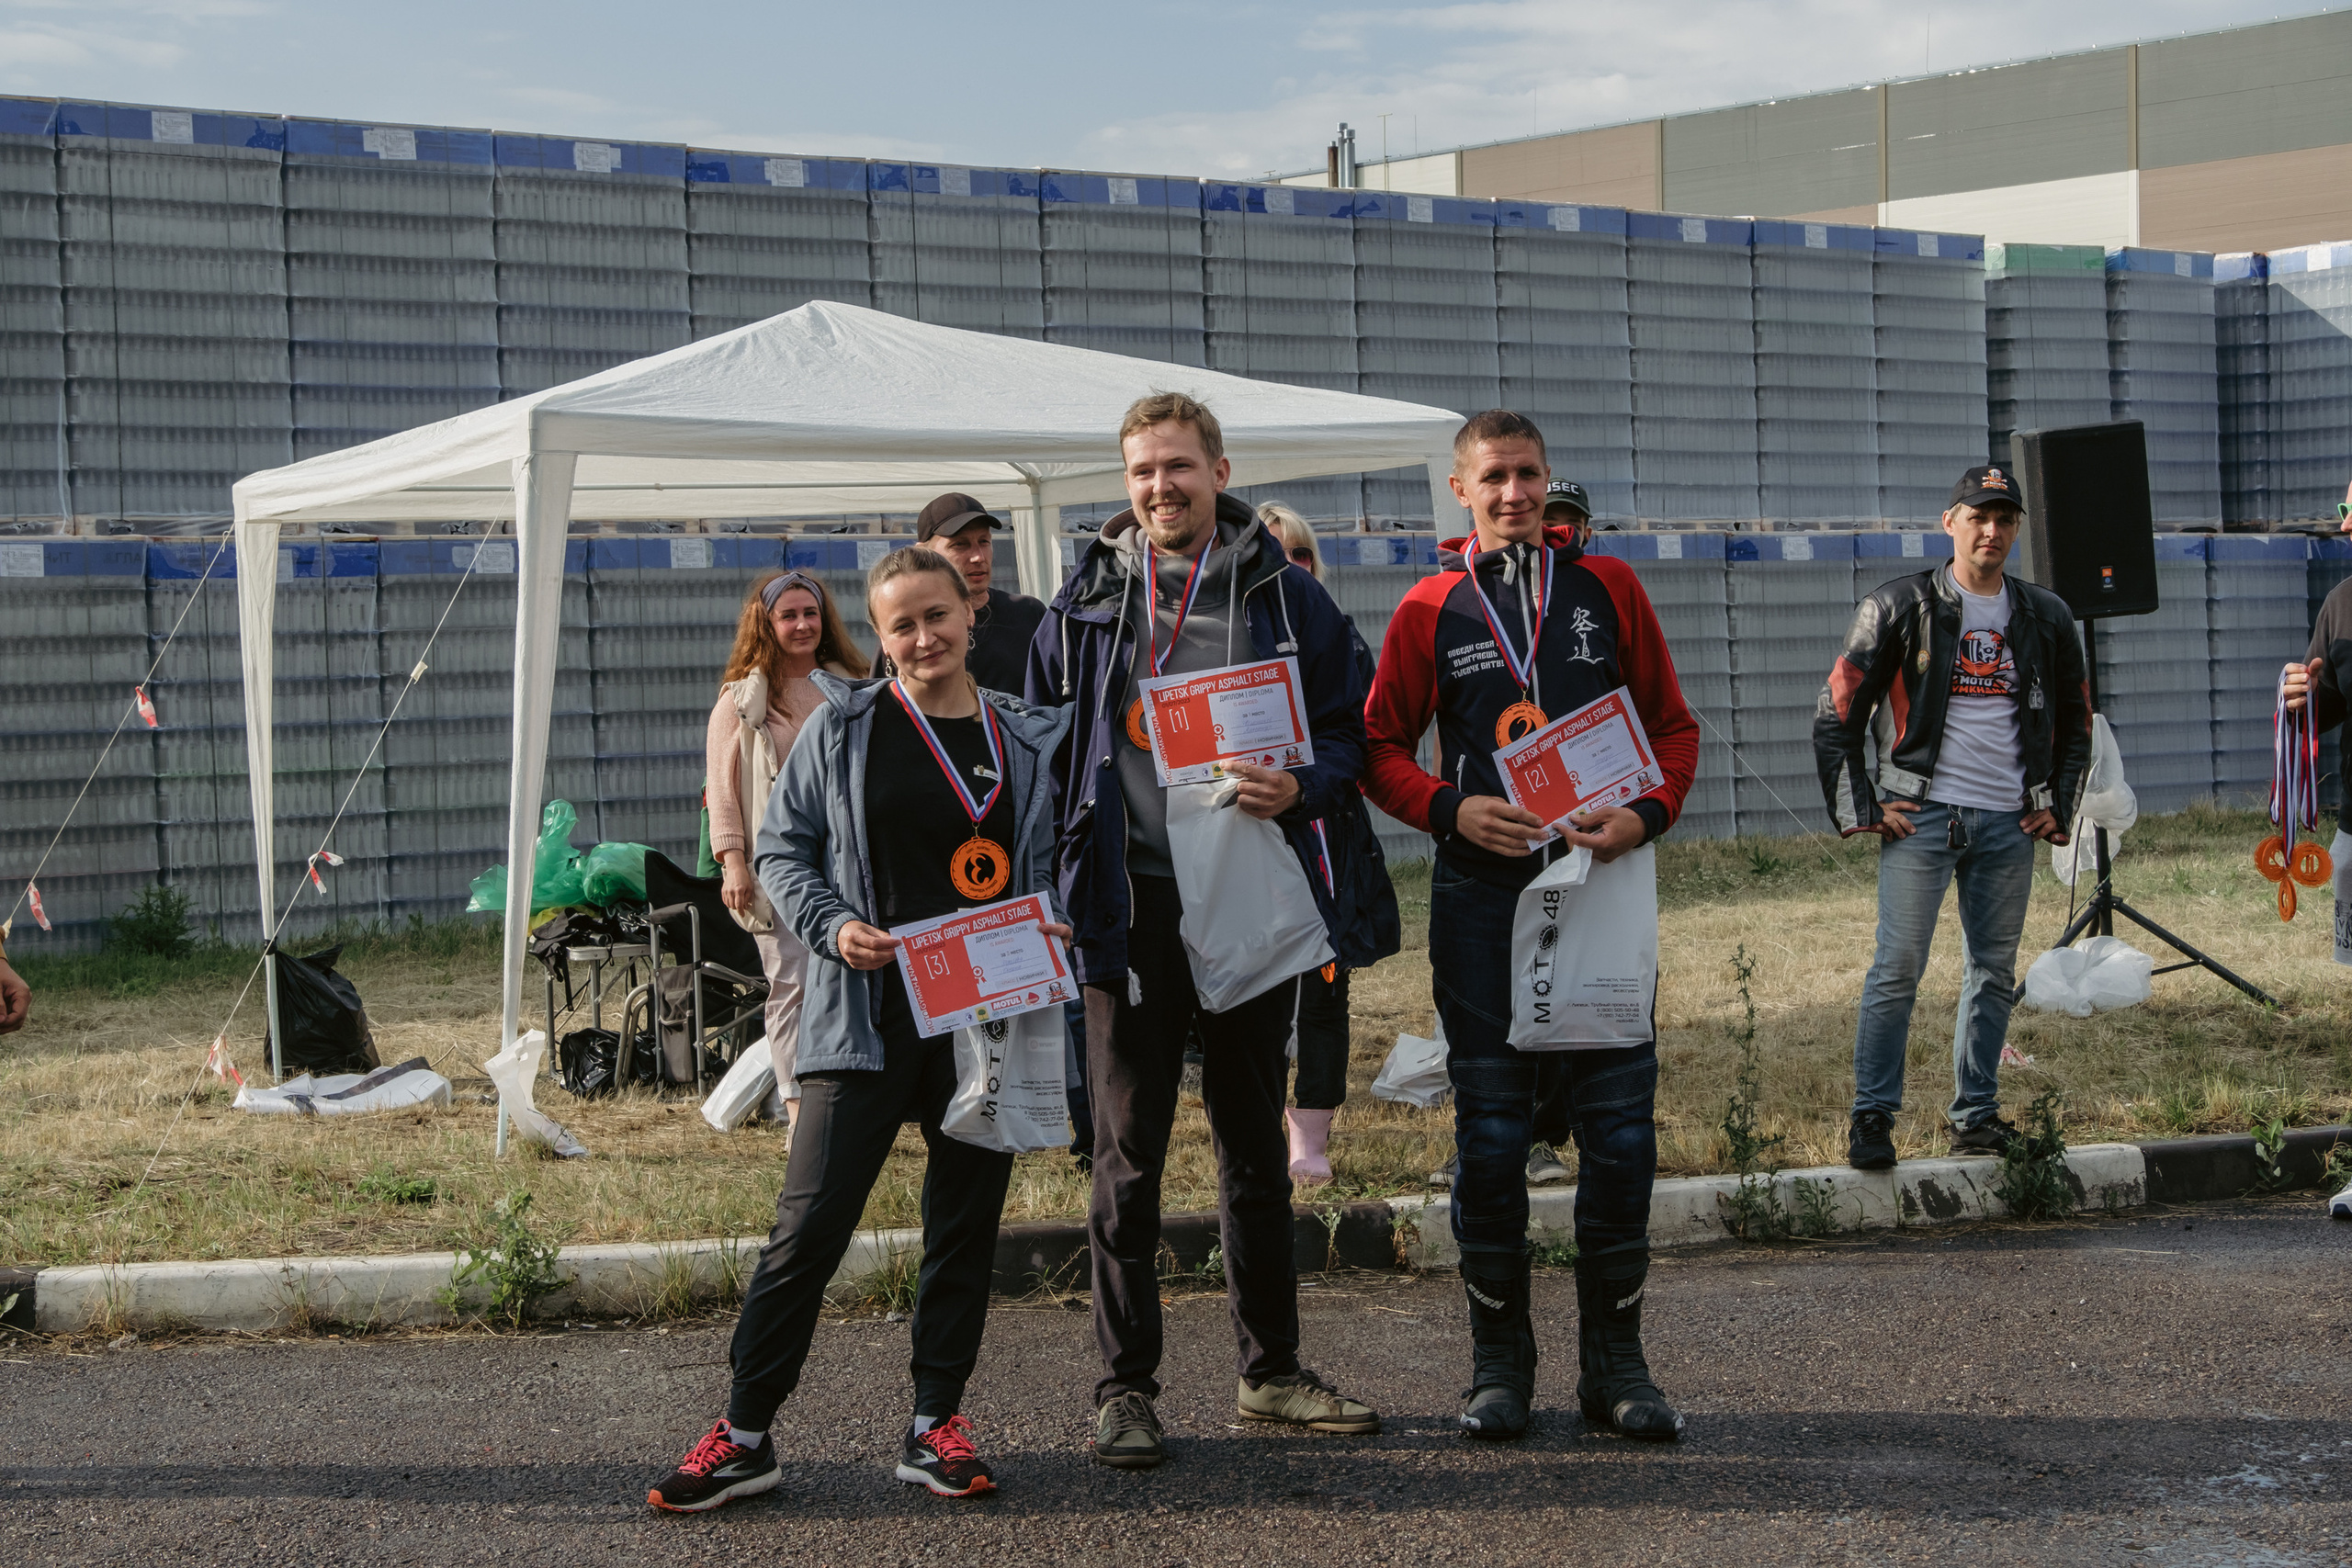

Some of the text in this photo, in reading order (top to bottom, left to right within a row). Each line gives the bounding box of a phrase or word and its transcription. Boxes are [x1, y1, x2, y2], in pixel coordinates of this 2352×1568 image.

[1476, 640, 1494, 650] СЕБЯ
[1159, 688, 1188, 703] LIPETSK
[1190, 682, 1216, 695] GRIPPY
[1219, 673, 1252, 689] ASPHALT
[1253, 668, 1279, 682] STAGE
[1952, 685, 2007, 694] YMKHANA
[1960, 675, 1994, 686] MOTO
[1219, 689, 1273, 703] ДИПЛОМ DIPLOMA
[1511, 746, 1540, 769] LIPETSK
[1540, 732, 1563, 751] GRIPPY
[1564, 715, 1593, 739] ASPHALT
[1593, 701, 1615, 721] STAGE
[1567, 722, 1614, 750] ДИПЛОМ DIPLOMA
[1590, 794, 1615, 809] MOTUL
[911, 931, 944, 950] LIPETSK
[944, 922, 971, 940] GRIPPY
[973, 912, 1006, 931] ASPHALT
[1007, 904, 1032, 920] STAGE
[975, 924, 1028, 944] ДИПЛОМ DIPLOMA
[993, 997, 1022, 1010] MOTUL
[1467, 1283, 1506, 1310] RUSH
[1616, 1281, 1645, 1310] RUS
